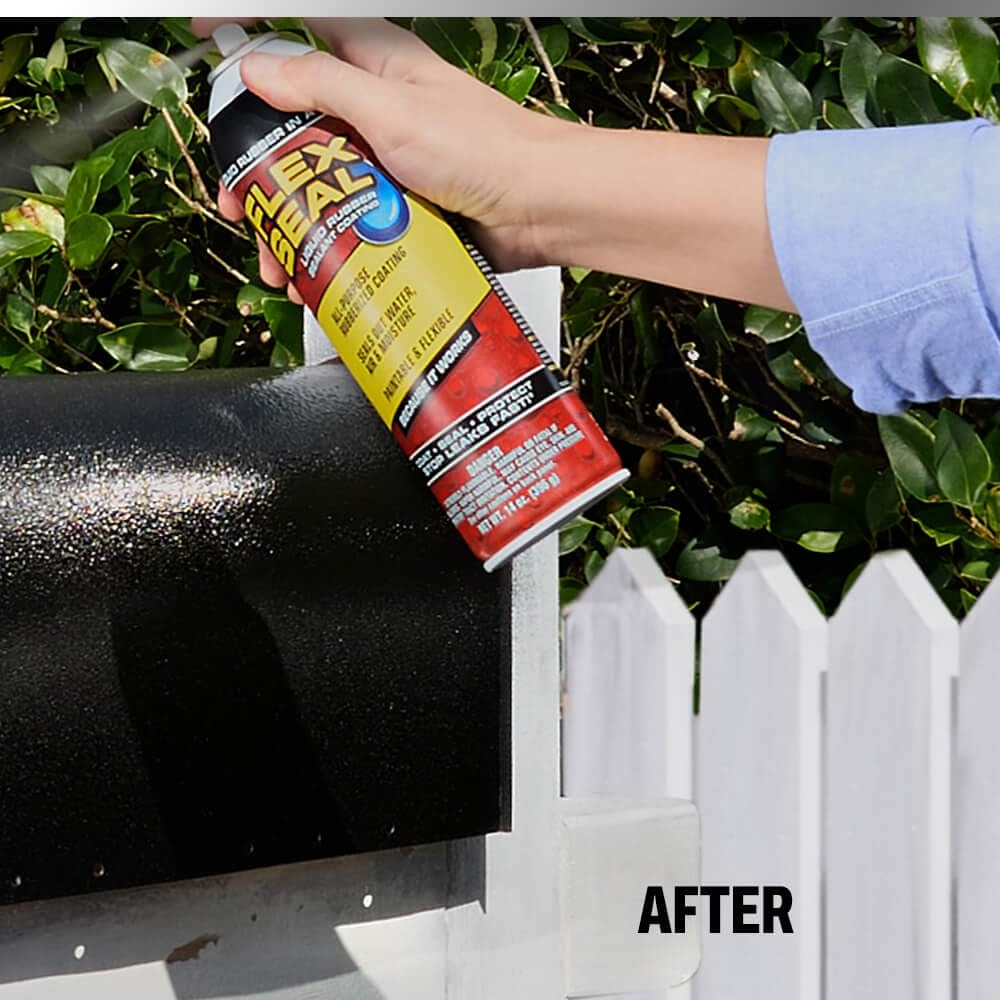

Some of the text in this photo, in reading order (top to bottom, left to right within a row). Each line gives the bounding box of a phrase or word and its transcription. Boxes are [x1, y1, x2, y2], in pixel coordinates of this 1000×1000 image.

[237, 126, 286, 168] RUBBER
[285, 115, 302, 131] IN
[244, 135, 361, 242] FLEX
[269, 167, 375, 277] SEAL
[300, 191, 377, 268] LIQUID RUBBER
[308, 199, 380, 279] SEALANT COATING
[371, 245, 408, 289] COATING
[331, 267, 371, 326] ALL-PURPOSE
[356, 285, 417, 364] SEALS OUT WATER,
[365, 356, 378, 375] AIR
[378, 306, 416, 353] MOISTURE
[383, 307, 454, 401] PAINTABLE & FLEXIBLE
[398, 329, 473, 428] BECAUSE IT WORKS
[421, 455, 446, 477] STOP
[445, 423, 490, 459] LEAKS
[437, 425, 470, 450] SEAL
[476, 379, 534, 421] PROTECT
